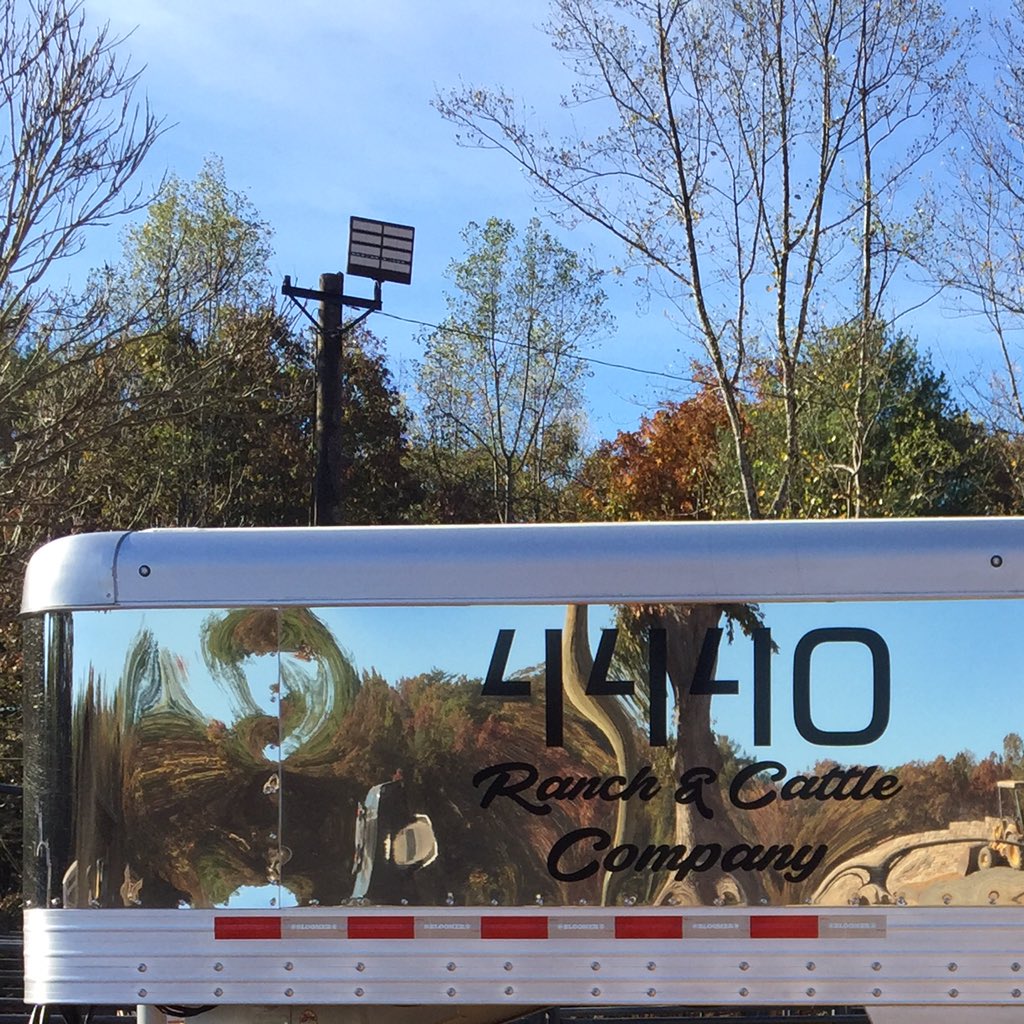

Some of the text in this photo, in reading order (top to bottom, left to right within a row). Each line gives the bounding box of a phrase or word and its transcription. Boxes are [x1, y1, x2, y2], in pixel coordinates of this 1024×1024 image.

[482, 627, 891, 746] 4440
[473, 761, 902, 819] Ranch & Cattle
[547, 827, 828, 883] Company
